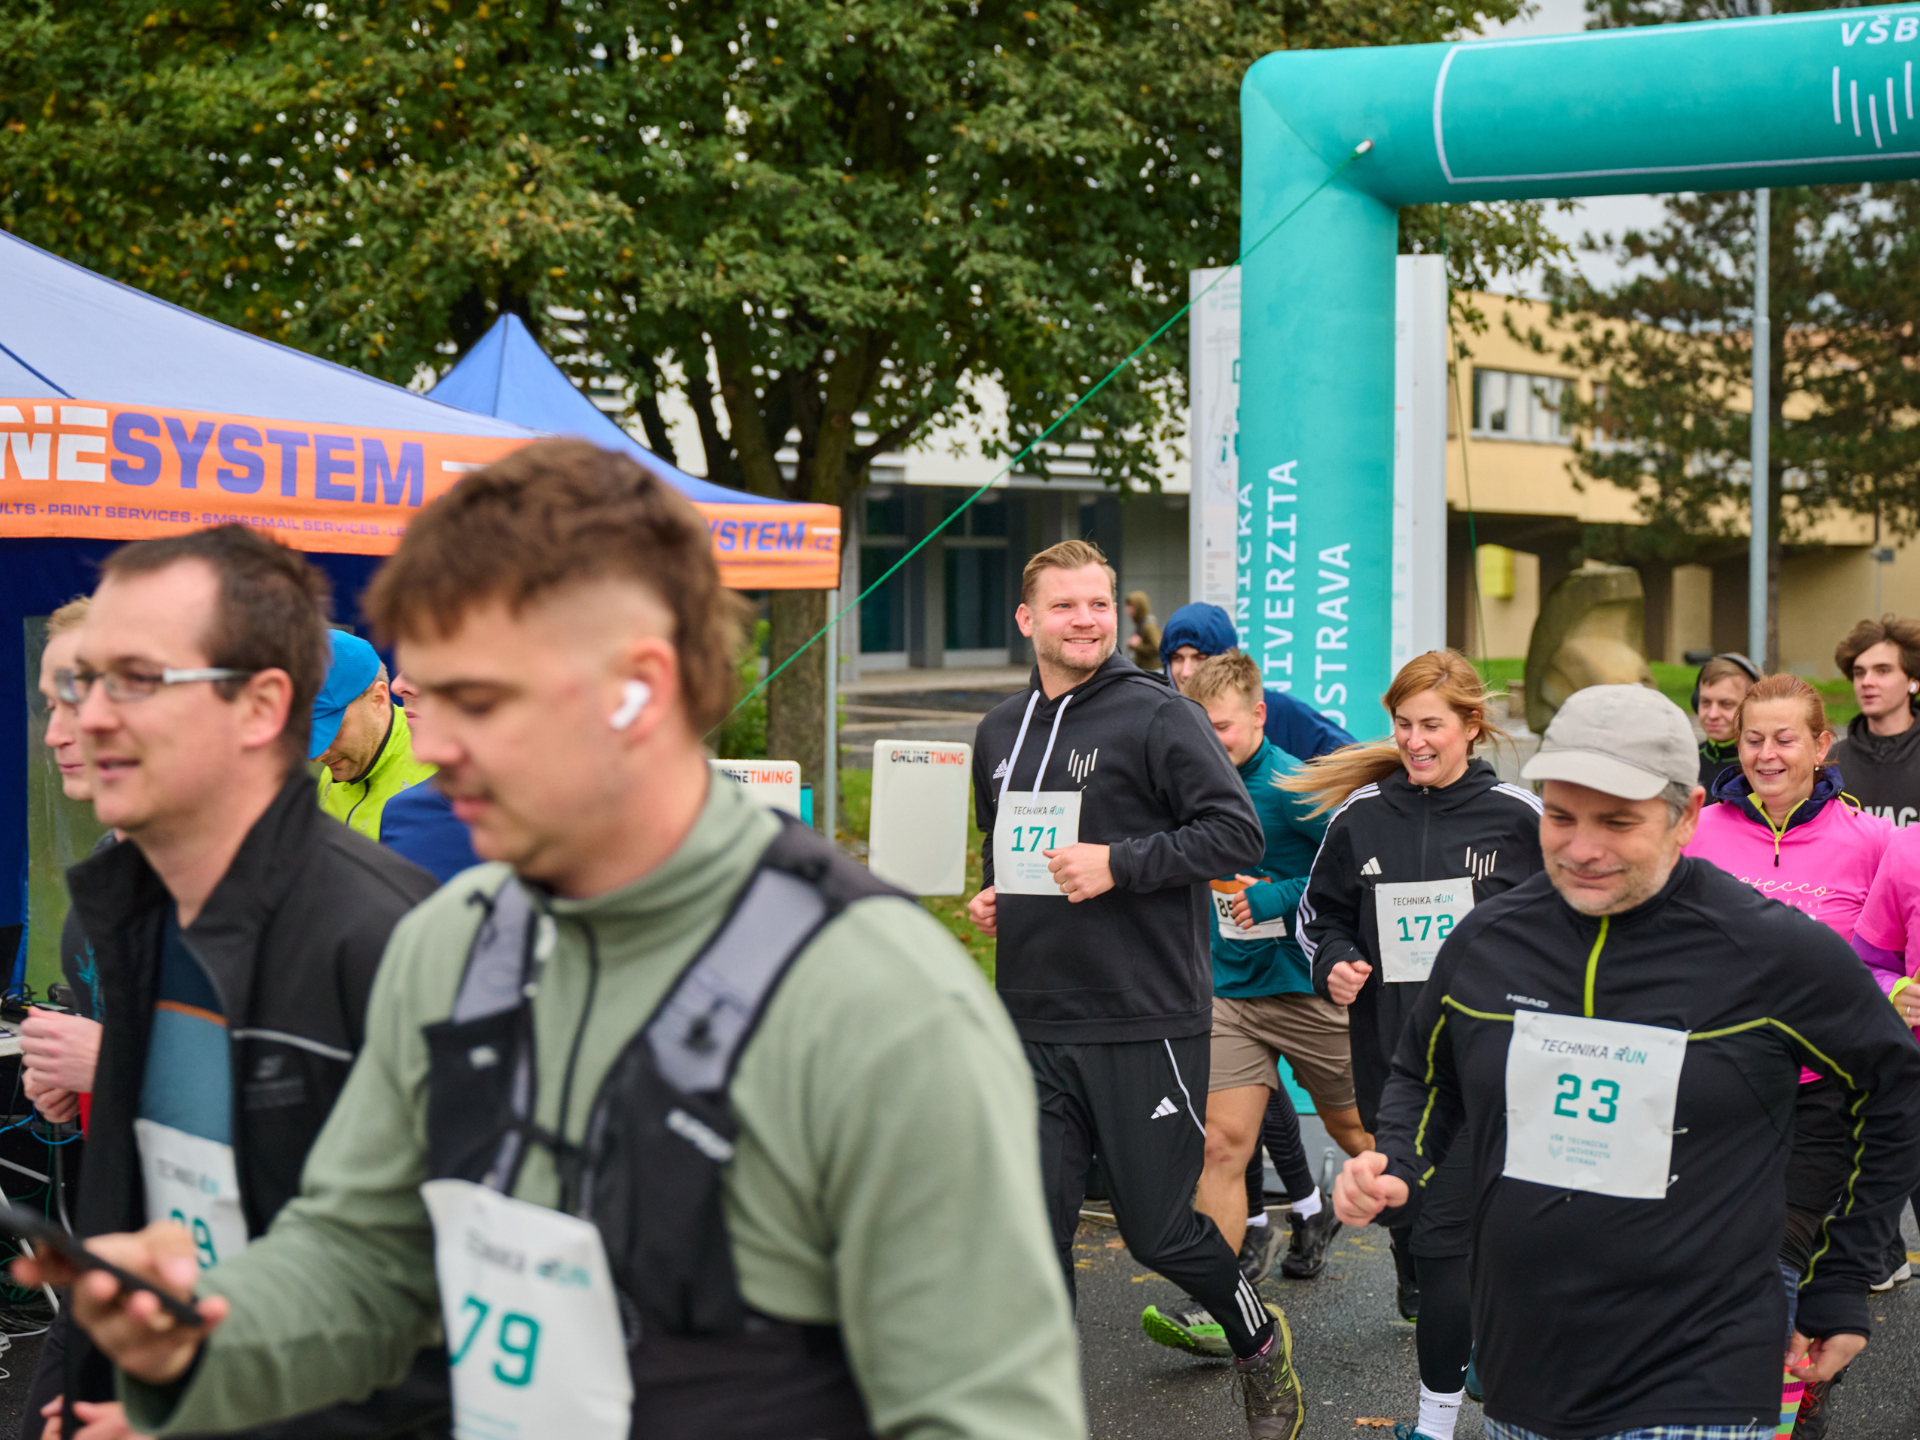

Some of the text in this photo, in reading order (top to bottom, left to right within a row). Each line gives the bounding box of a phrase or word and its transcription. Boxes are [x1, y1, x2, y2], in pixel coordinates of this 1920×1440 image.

[1841, 13, 1919, 47] VŠB
[48, 503, 101, 517] PRINT
[105, 506, 191, 523] SERVICES
[303, 519, 379, 536] SERVICES
[891, 750, 964, 765] ONLINETIMING
[1013, 806, 1048, 816] TECHNIKA
[1011, 825, 1058, 853] 171
[1393, 896, 1432, 906] TECHNIKA
[1397, 913, 1454, 942] 172
[1506, 993, 1549, 1009] HEAD
[1541, 1038, 1648, 1065] TECHNIKA RUN
[1553, 1073, 1620, 1124] 23
